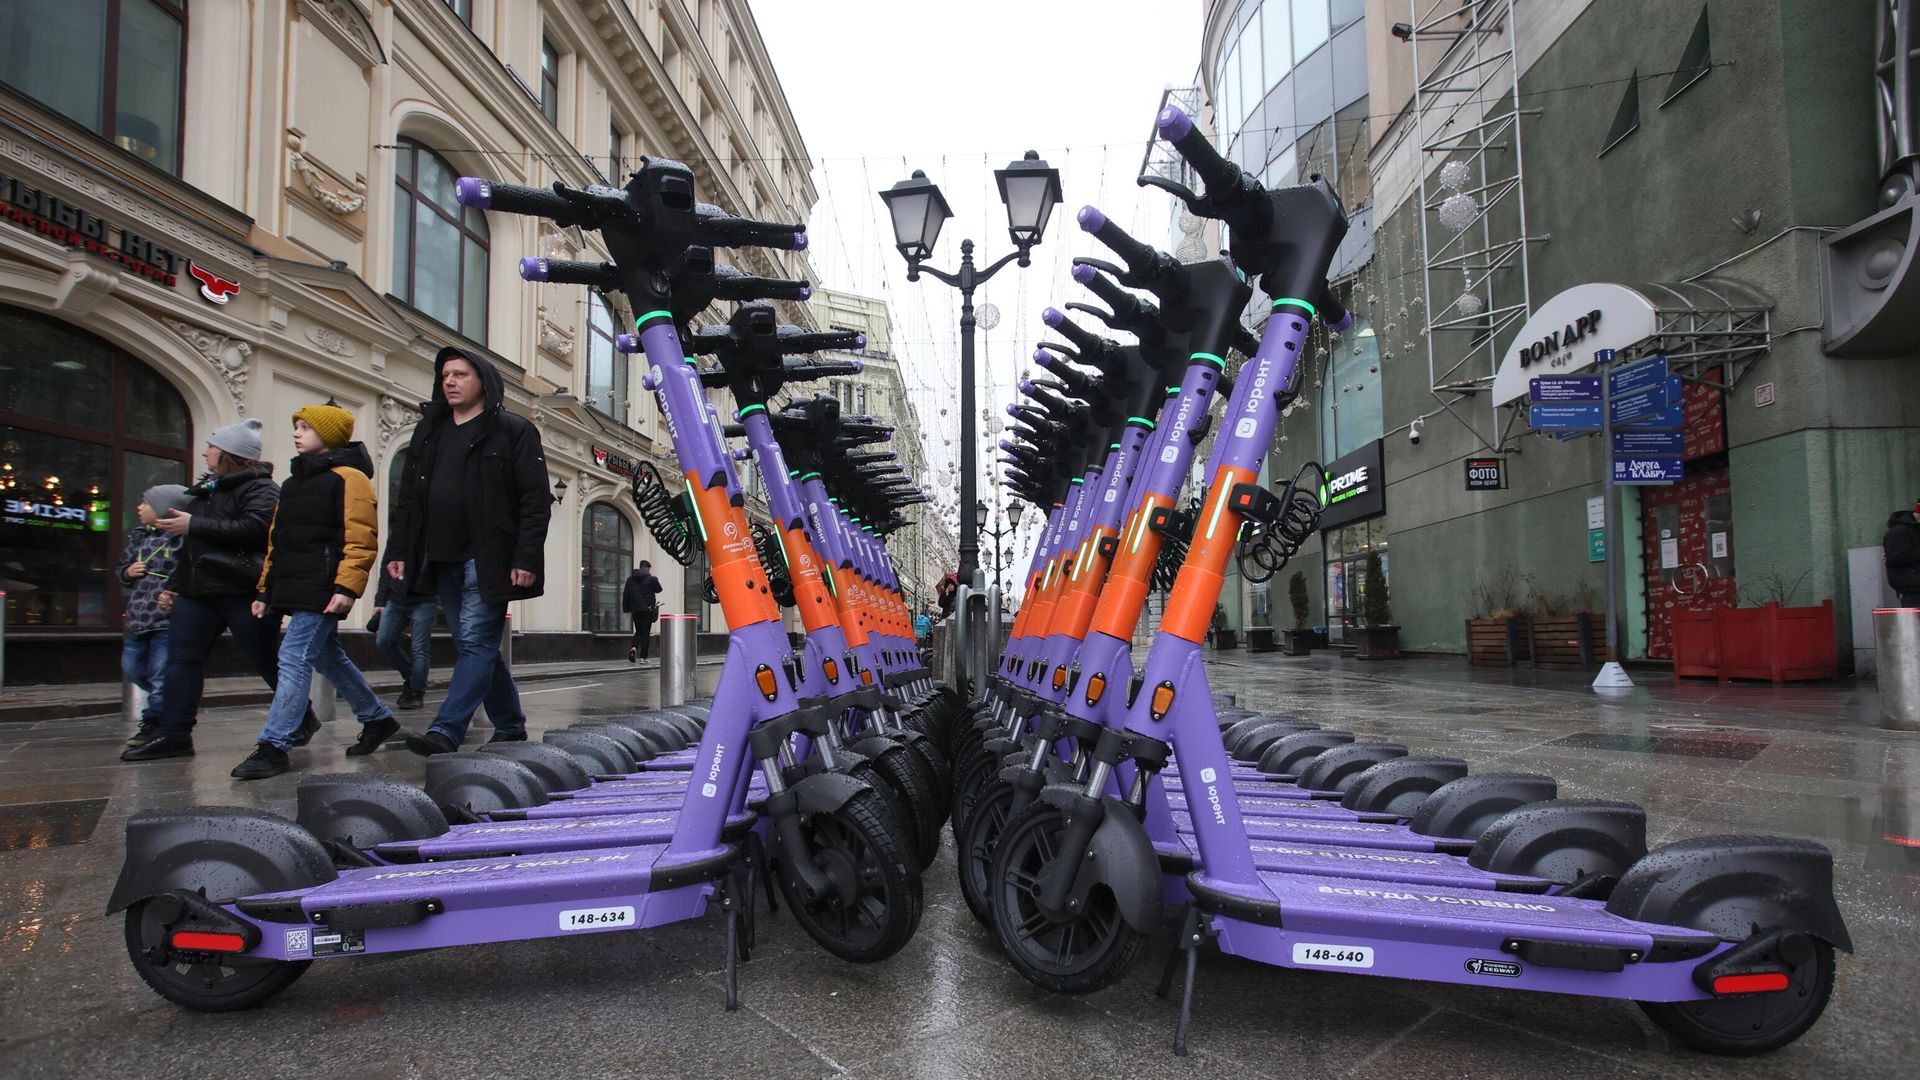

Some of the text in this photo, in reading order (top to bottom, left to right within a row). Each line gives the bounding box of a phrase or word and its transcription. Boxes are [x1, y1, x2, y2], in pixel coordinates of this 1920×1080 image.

[0, 174, 183, 274] ЫБЫ НЕТ
[87, 239, 176, 287] РЕСТОРАН
[1519, 309, 1603, 369] BON APP
[1246, 358, 1271, 413] юрент
[658, 388, 679, 439] юрент
[1170, 396, 1192, 441] юрент
[1111, 451, 1126, 486] юрент
[1330, 466, 1368, 494] PRIME
[1469, 468, 1497, 479] ФОТО
[708, 743, 724, 780] юрент
[1208, 785, 1225, 825] юрент
[366, 866, 490, 881] ПРОБКАХ
[516, 857, 588, 868] СТОЮ
[1339, 853, 1441, 866] ПРОБКАХ
[1318, 886, 1556, 913] ВСЕГДА УСПЕВАЮ
[571, 911, 625, 925] 148-634
[1306, 949, 1364, 962] 148-640
